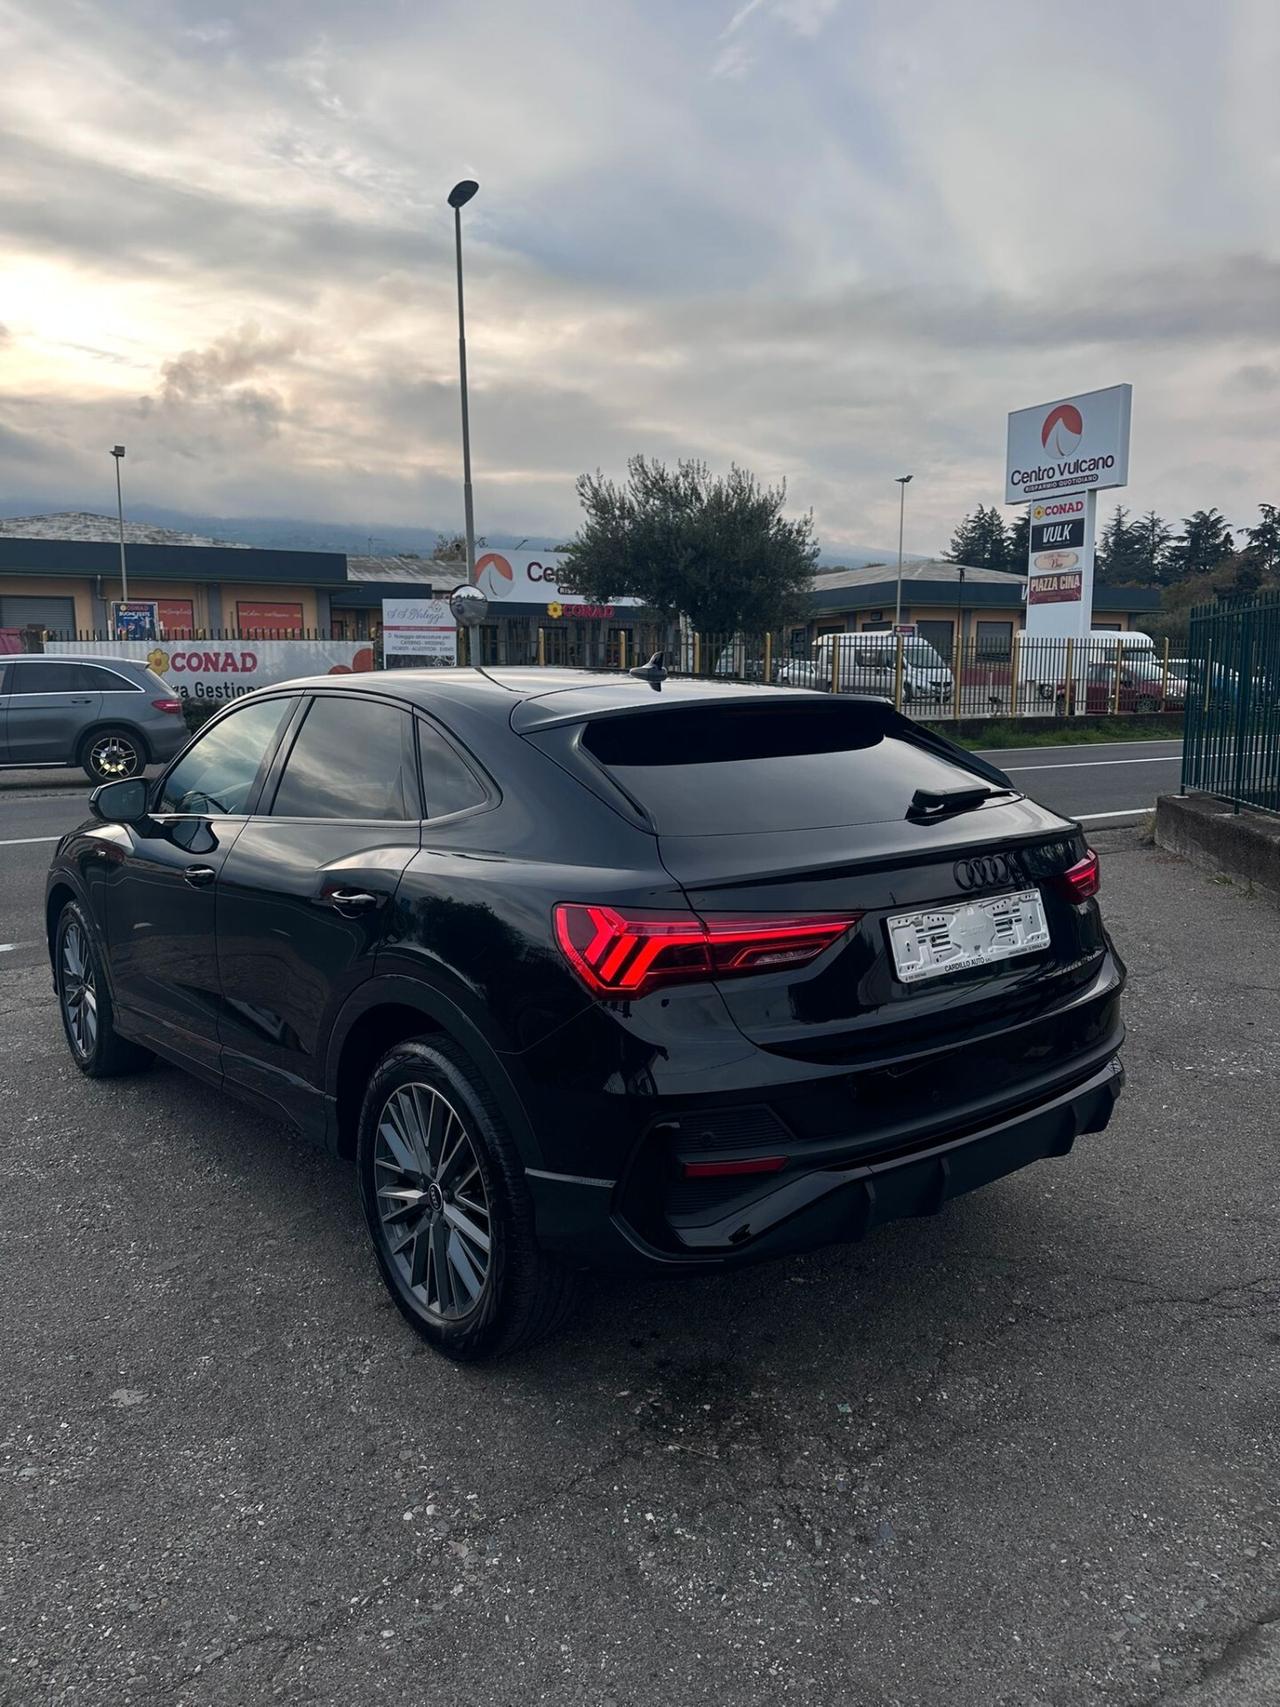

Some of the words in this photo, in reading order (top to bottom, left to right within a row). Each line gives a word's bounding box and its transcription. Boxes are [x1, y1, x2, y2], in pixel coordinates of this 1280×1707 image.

[1011, 466, 1055, 486] Centro
[1058, 455, 1115, 476] Vulcano
[1025, 481, 1058, 493] RISPARMIO
[1058, 475, 1098, 487] QUOTIDIANO
[1044, 500, 1084, 517] CONAD
[1042, 523, 1073, 543] VULK
[1030, 576, 1058, 592] PIAZZA
[1060, 574, 1081, 590] CINA
[562, 604, 615, 618] CONAD
[170, 652, 258, 673] CONAD
[944, 959, 971, 973] CARDILLO
[971, 956, 985, 968] AUTO
